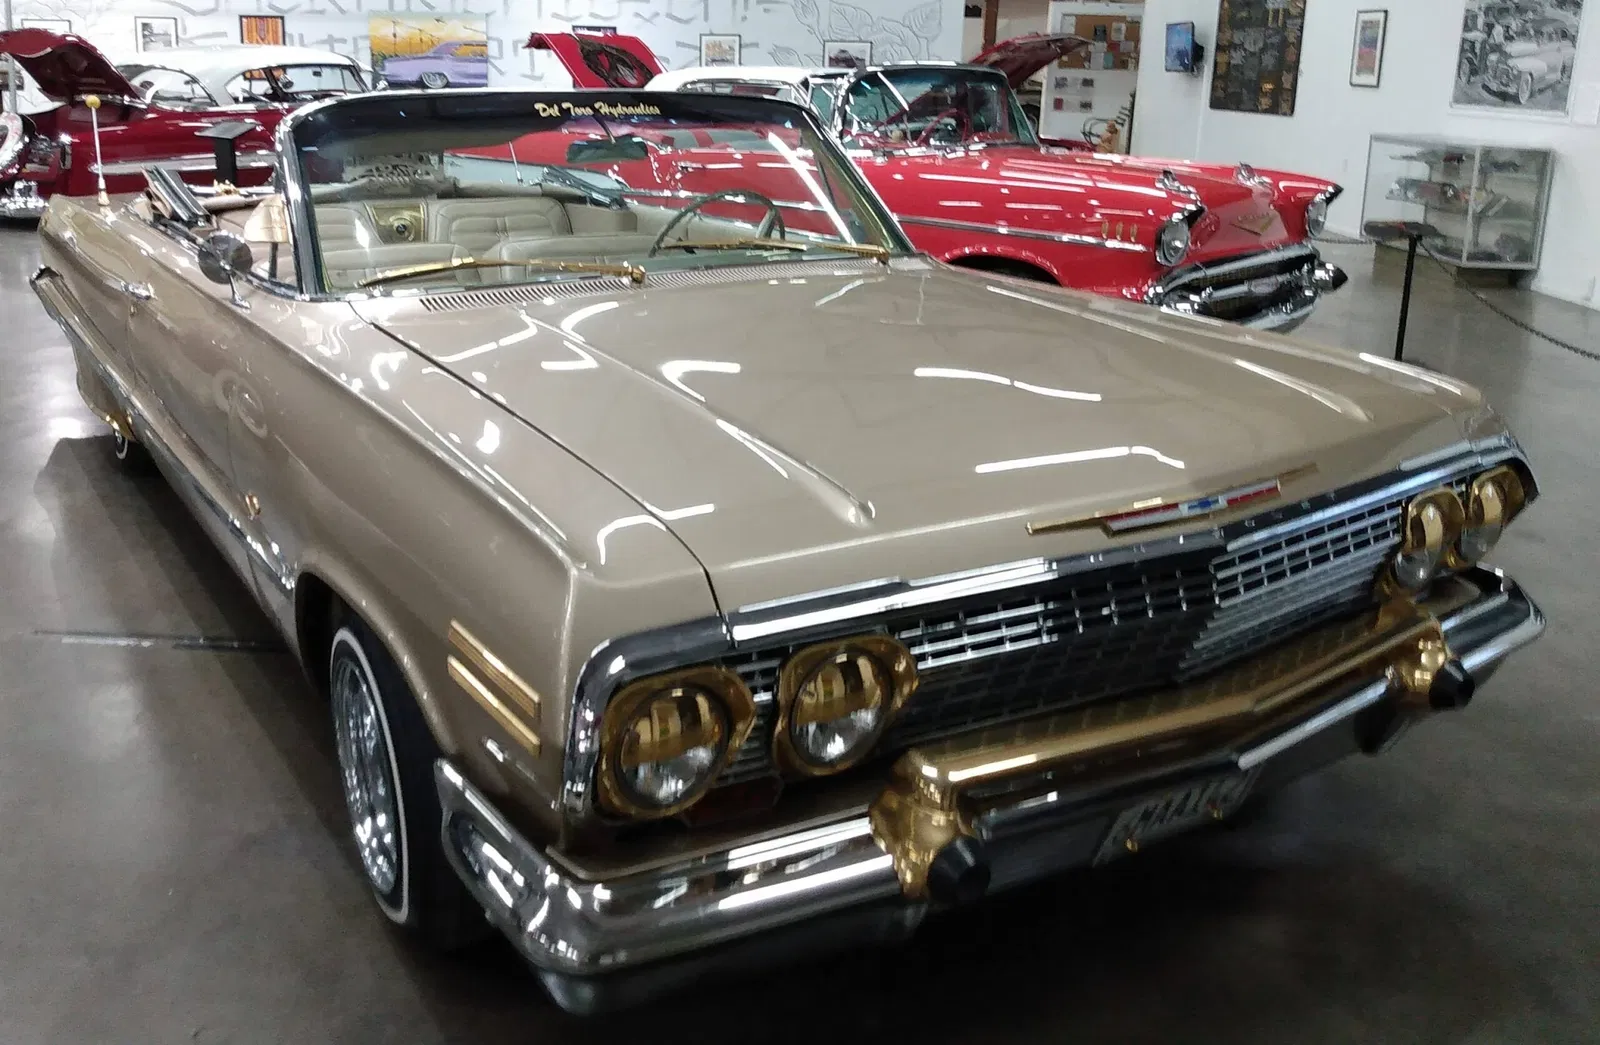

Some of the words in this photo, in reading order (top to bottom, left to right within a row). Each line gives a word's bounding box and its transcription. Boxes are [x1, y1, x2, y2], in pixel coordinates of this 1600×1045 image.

[534, 102, 561, 117] Del
[561, 102, 594, 116] Toro
[594, 101, 661, 118] Hydraulics
